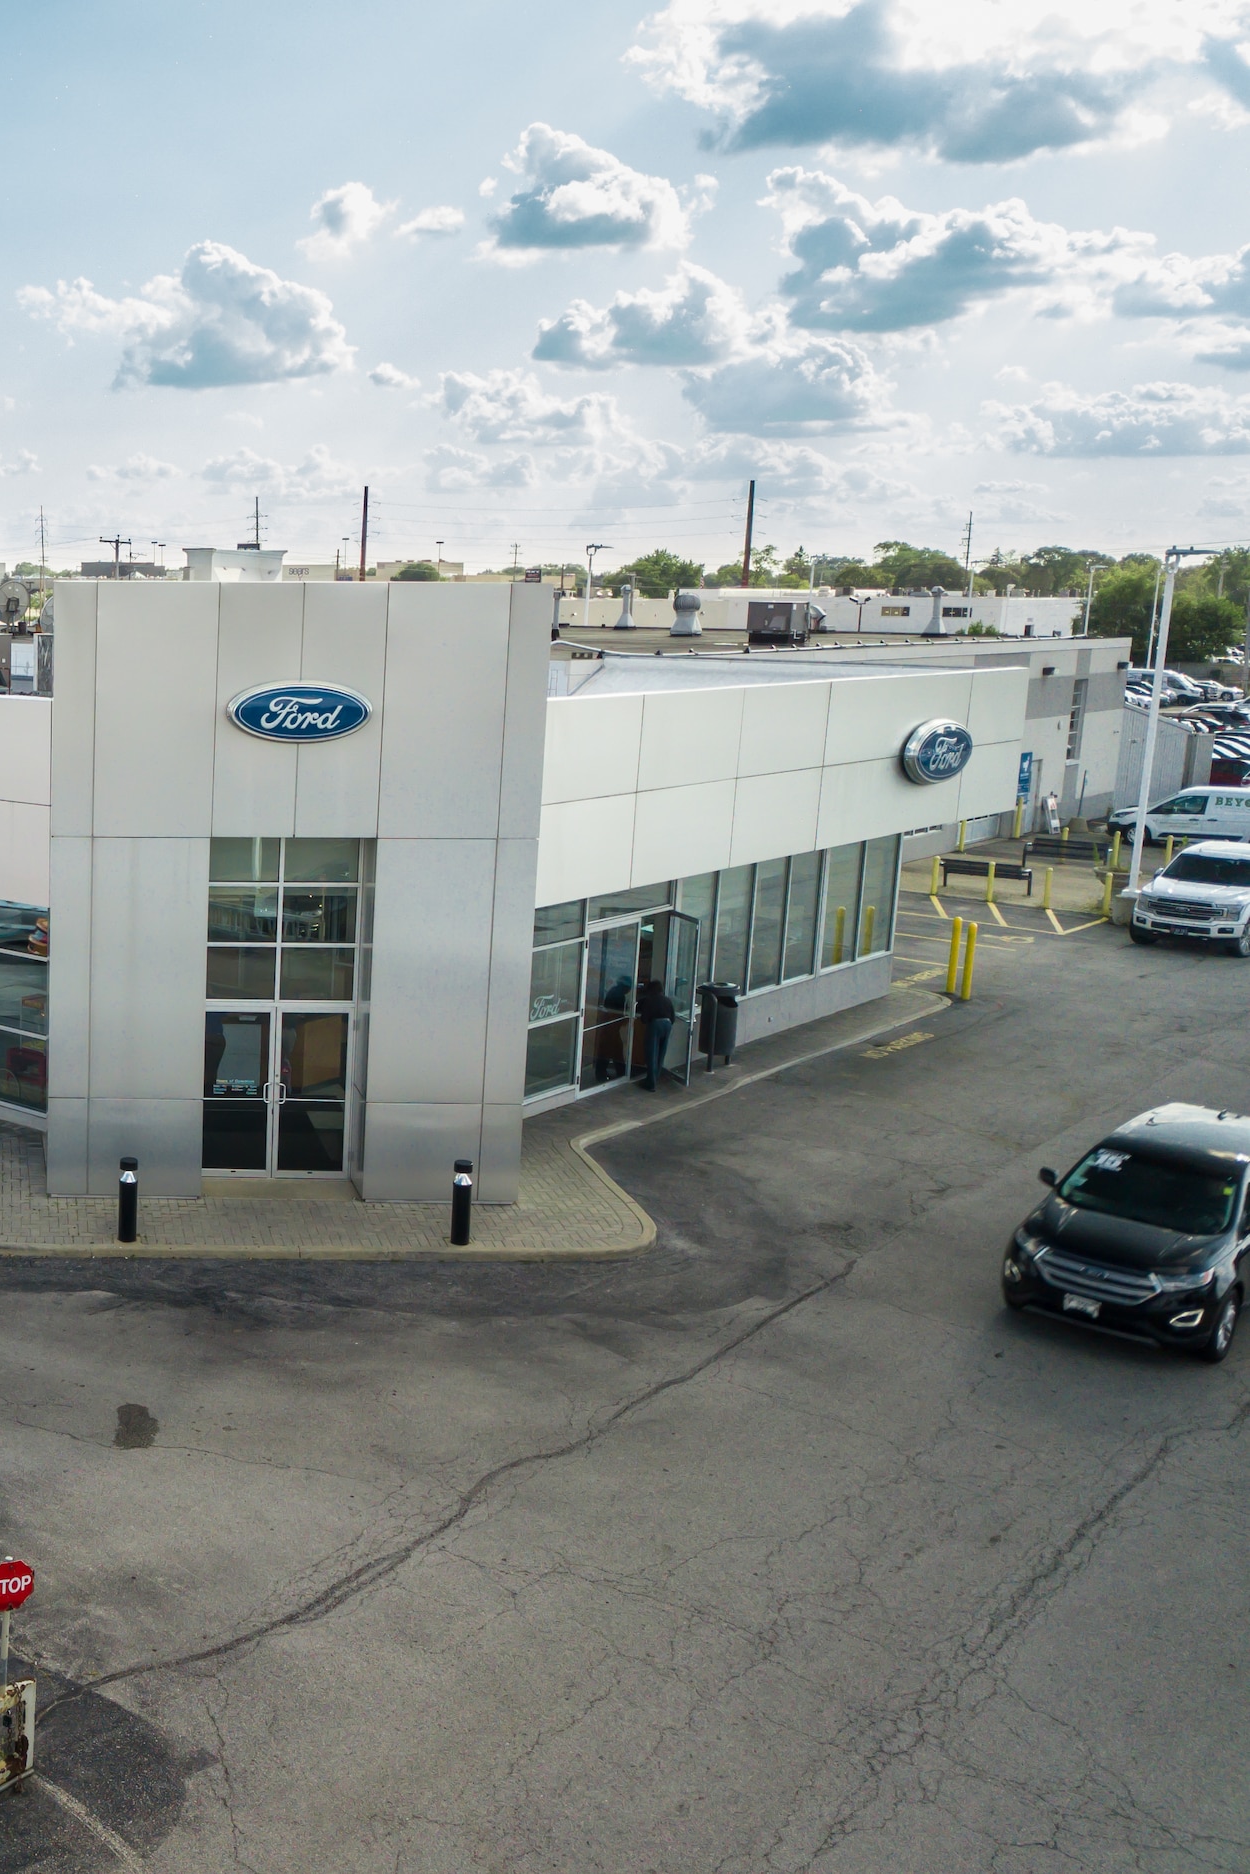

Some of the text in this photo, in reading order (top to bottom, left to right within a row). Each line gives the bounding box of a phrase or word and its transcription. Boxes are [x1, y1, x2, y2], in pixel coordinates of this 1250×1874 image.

[260, 696, 344, 730] Ford
[930, 736, 965, 771] Ford
[530, 994, 562, 1021] Ford
